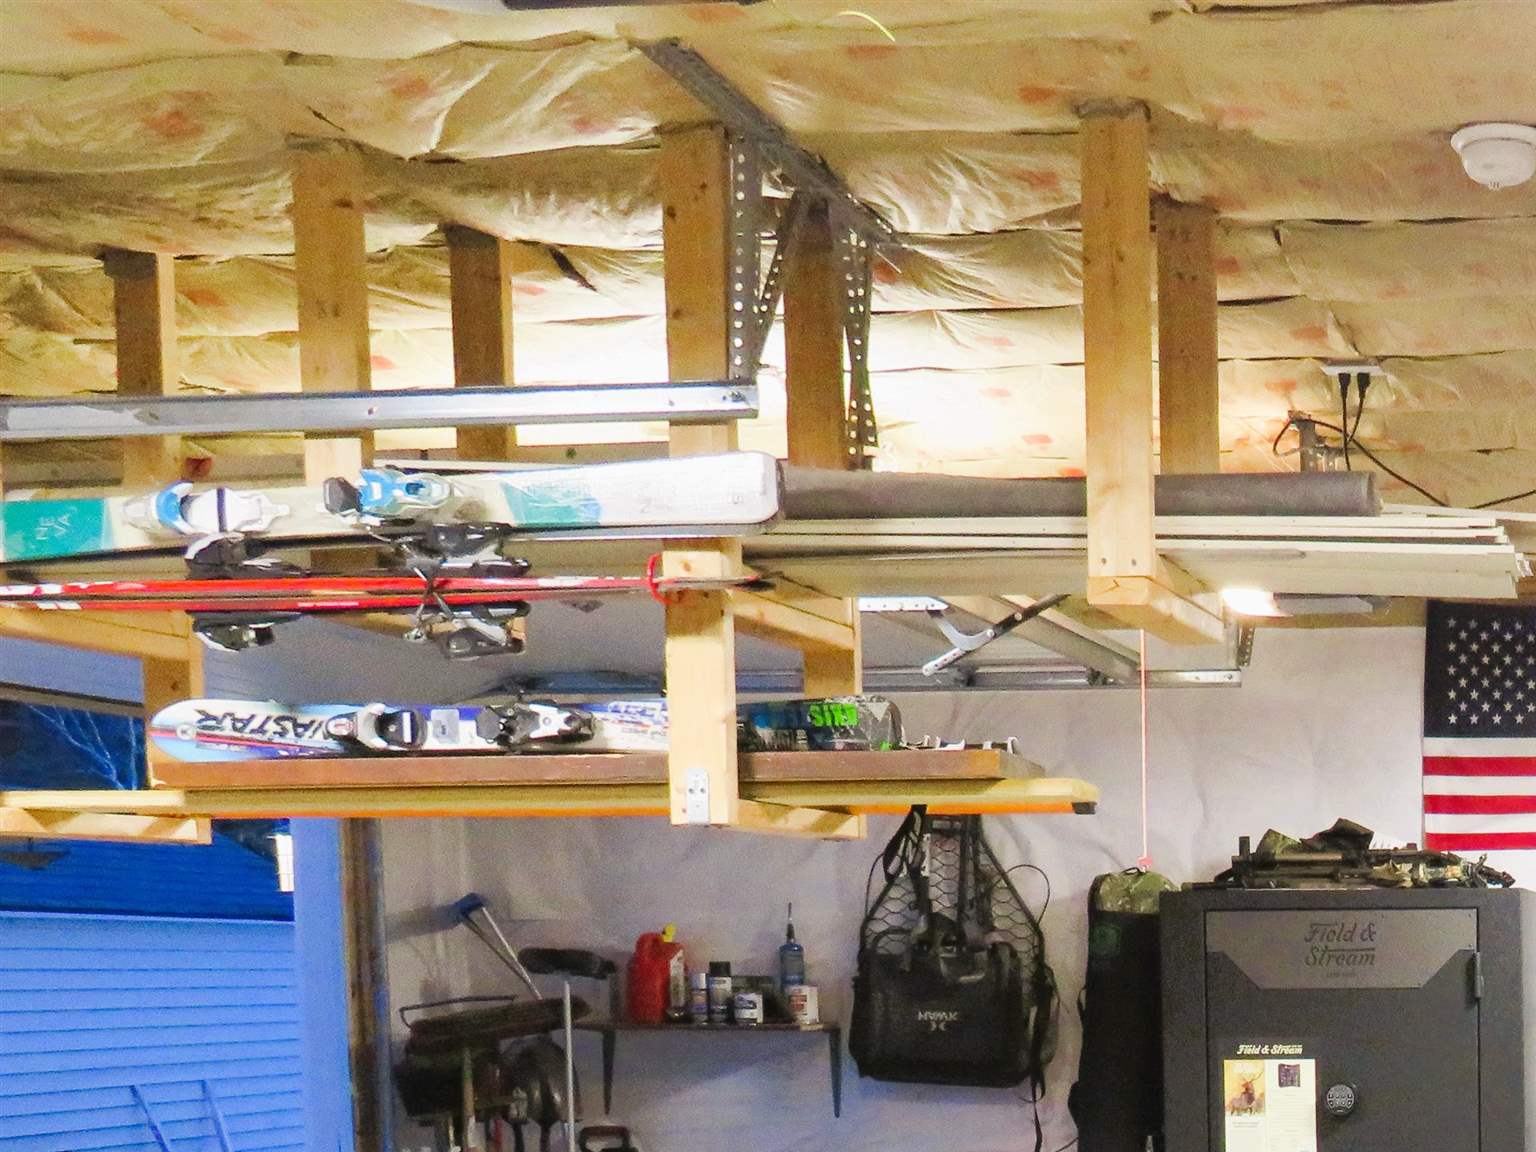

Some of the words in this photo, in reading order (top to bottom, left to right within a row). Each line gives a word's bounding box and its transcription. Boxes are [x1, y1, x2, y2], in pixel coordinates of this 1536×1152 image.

[1303, 922, 1357, 943] Field
[1360, 922, 1377, 942] &
[1304, 945, 1376, 967] Stream
[1236, 1044, 1262, 1055] Field
[1270, 1044, 1303, 1055] Stream
